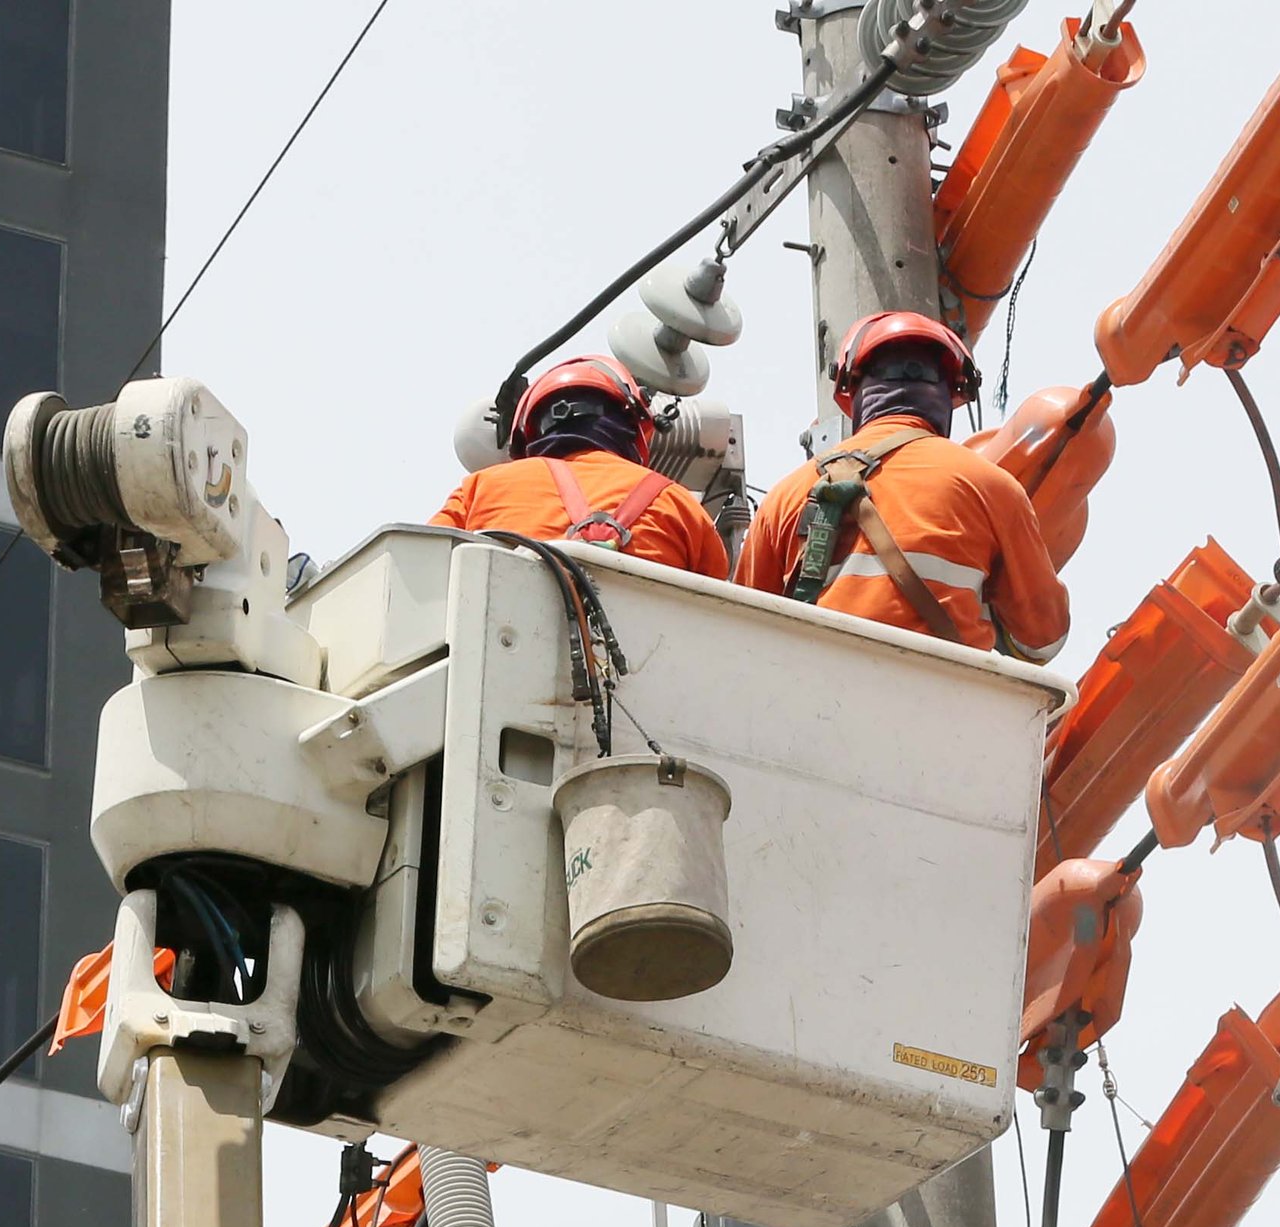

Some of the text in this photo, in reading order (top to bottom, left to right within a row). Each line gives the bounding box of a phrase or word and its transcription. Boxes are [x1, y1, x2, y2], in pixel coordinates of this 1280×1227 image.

[804, 529, 829, 574] BUCK
[895, 1050, 927, 1067] RATED
[932, 1059, 958, 1076] LOAD
